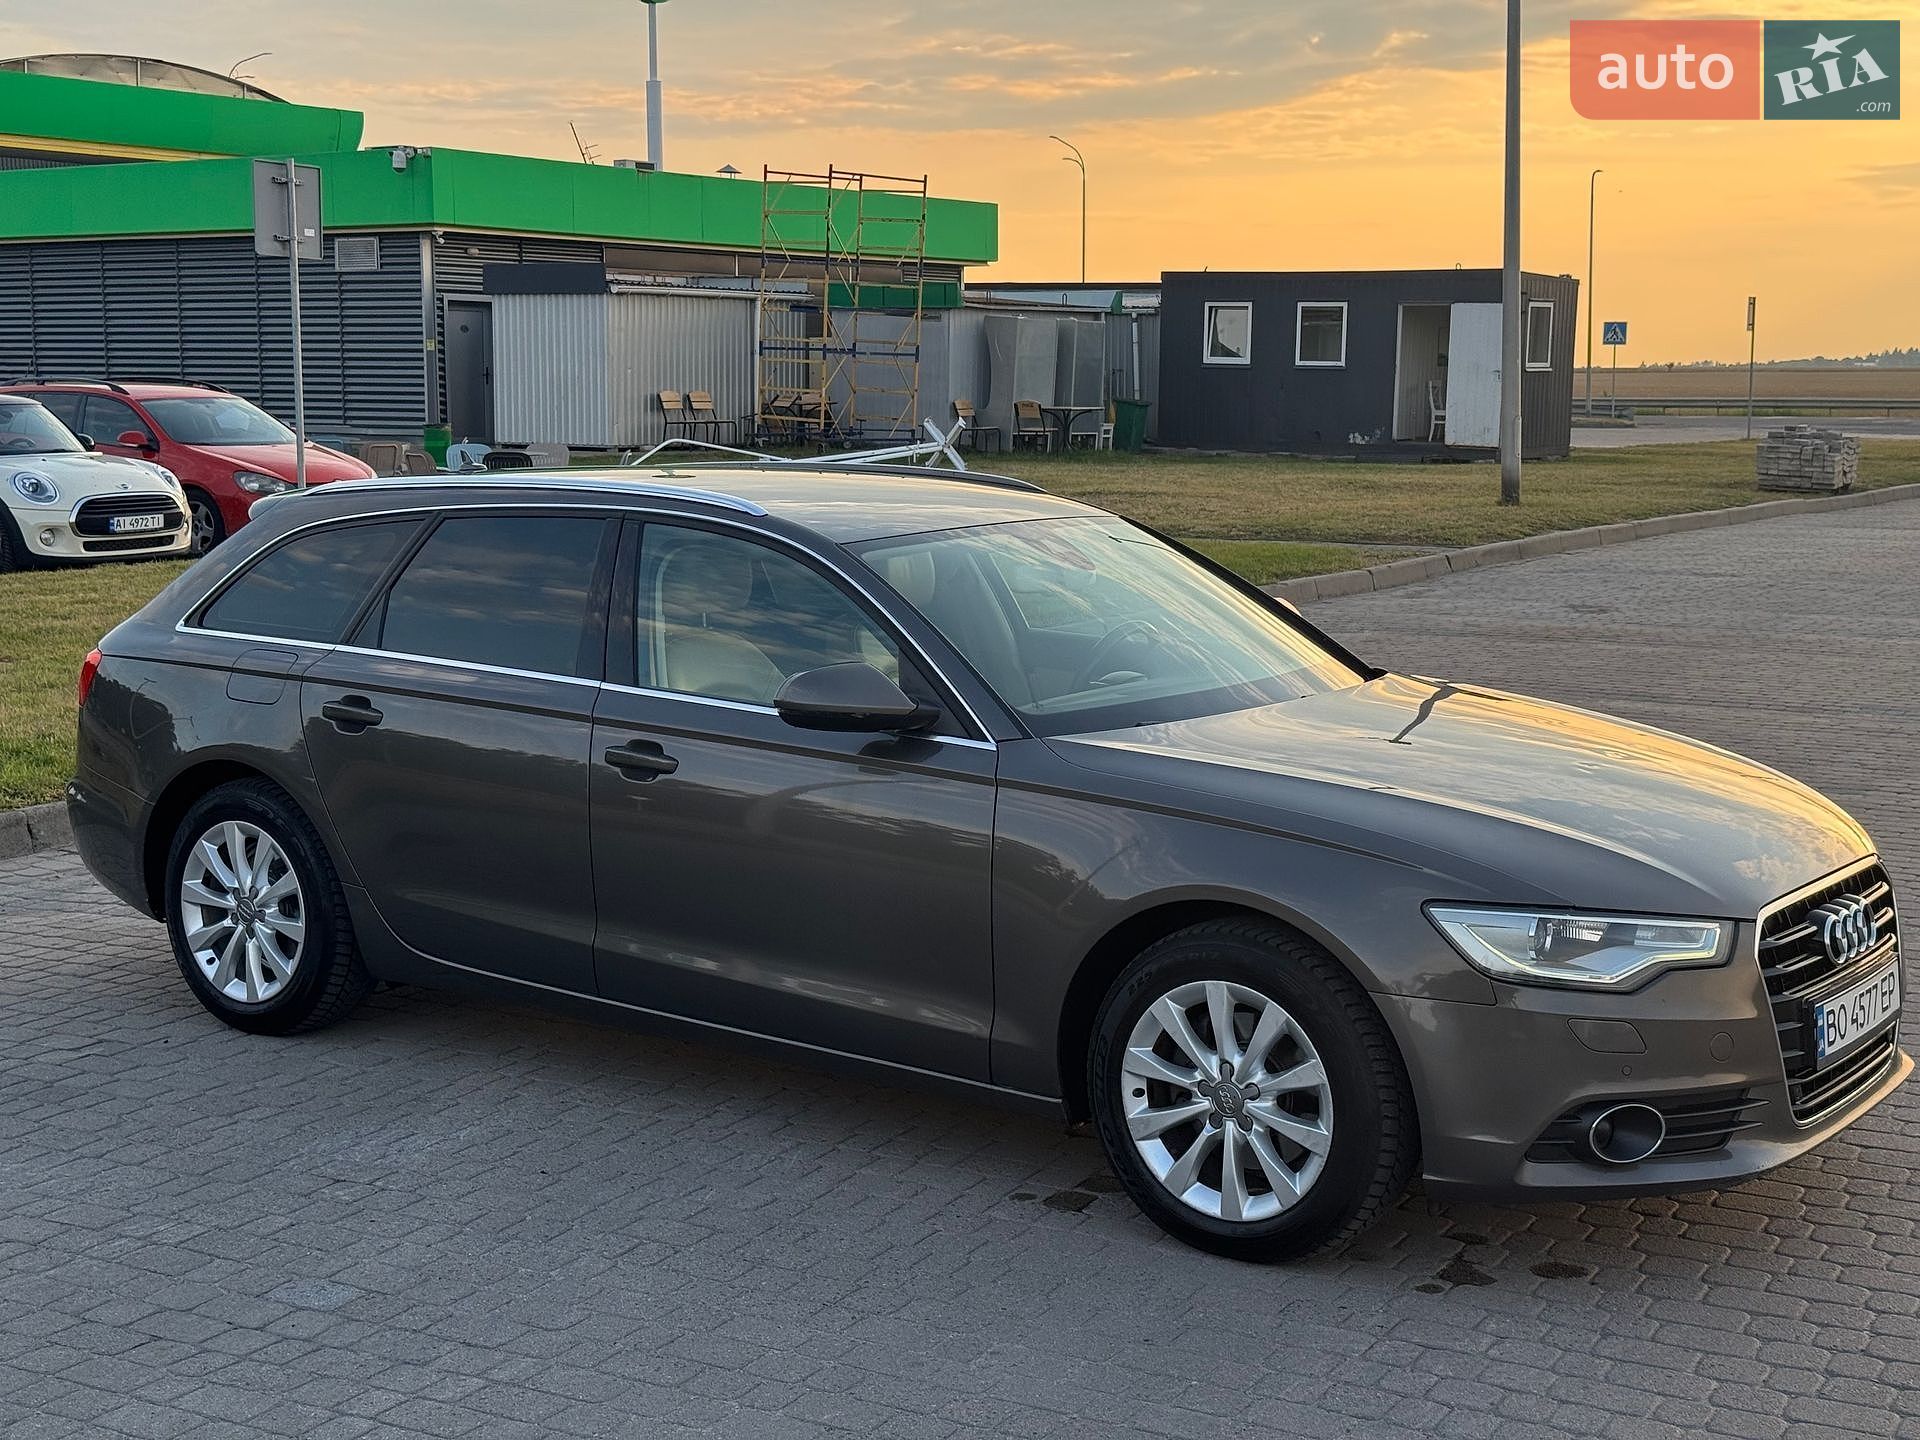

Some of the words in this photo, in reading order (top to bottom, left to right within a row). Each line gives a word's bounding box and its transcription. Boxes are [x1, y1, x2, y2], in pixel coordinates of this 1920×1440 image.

[115, 518, 126, 530] AI
[129, 517, 149, 529] 4972
[151, 516, 160, 527] TI
[1826, 1003, 1848, 1048] BO
[1851, 983, 1878, 1032] 4577
[1881, 971, 1895, 1013] EP
